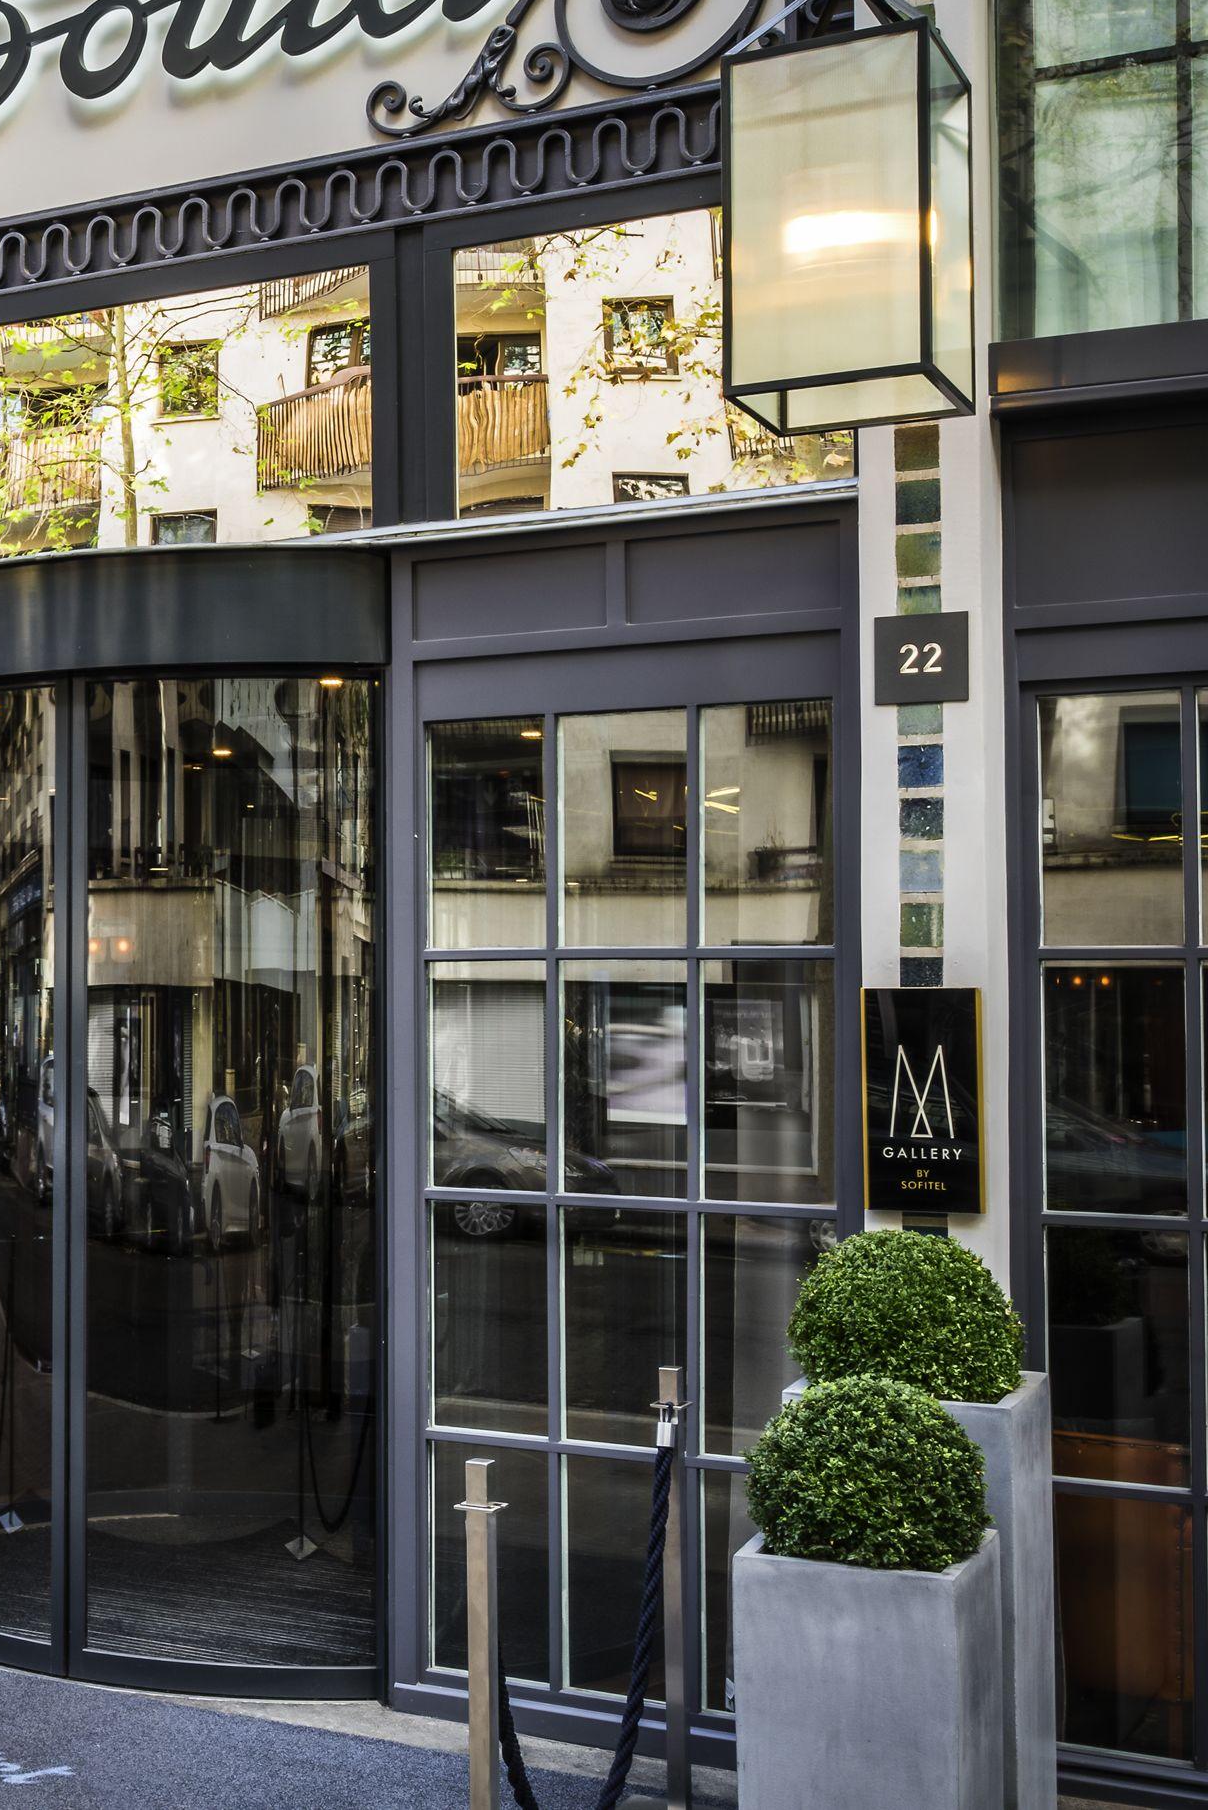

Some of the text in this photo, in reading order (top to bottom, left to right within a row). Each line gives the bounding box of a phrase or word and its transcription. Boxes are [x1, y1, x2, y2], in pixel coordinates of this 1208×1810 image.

[899, 642, 942, 674] 22
[882, 1146, 963, 1161] GALLERY
[916, 1169, 930, 1179] BY
[901, 1180, 947, 1191] SOFITEL
